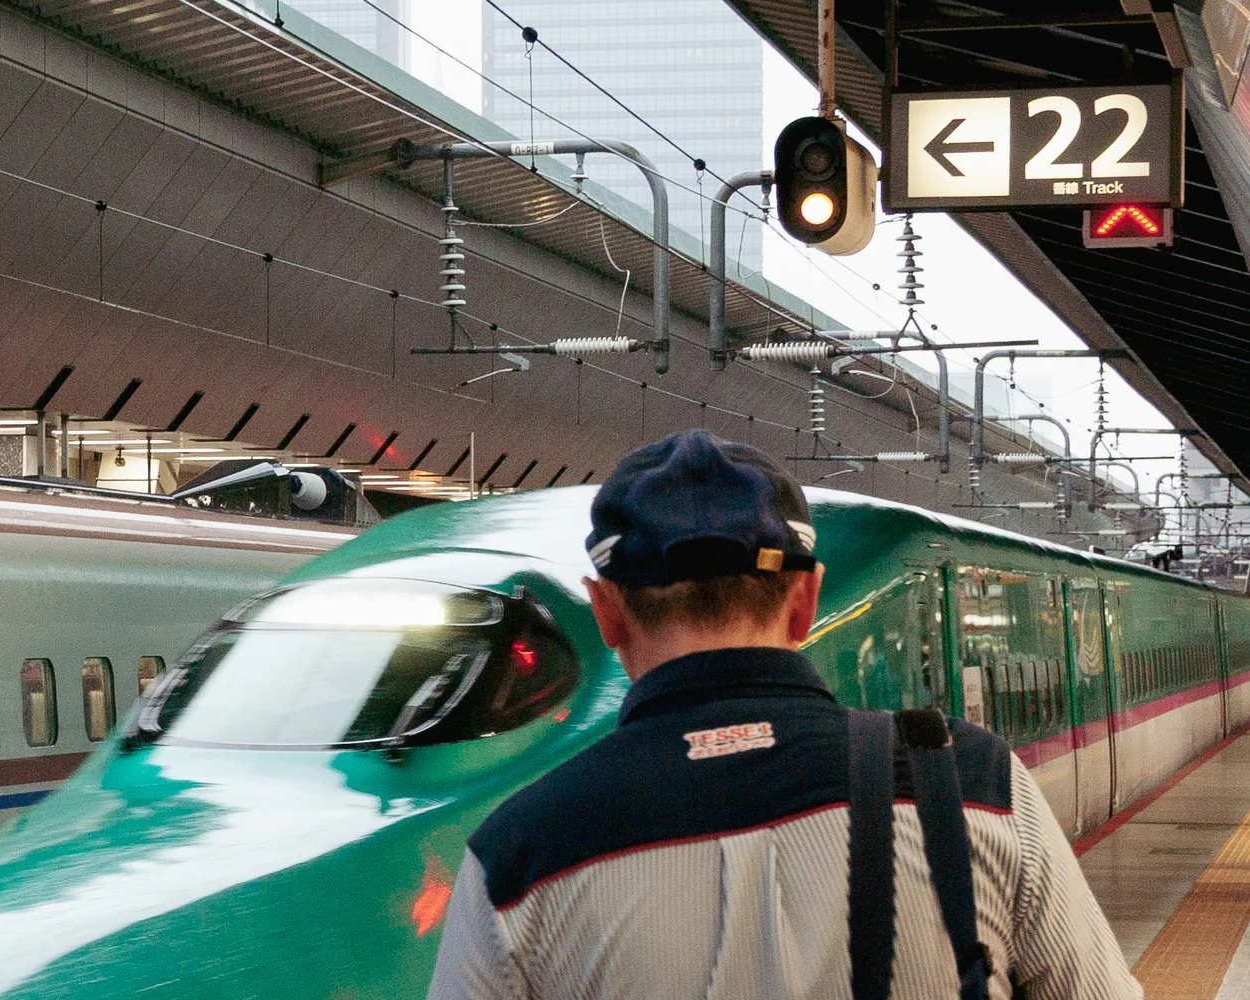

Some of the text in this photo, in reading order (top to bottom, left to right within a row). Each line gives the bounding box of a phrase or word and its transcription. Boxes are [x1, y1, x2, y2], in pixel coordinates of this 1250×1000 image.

[1025, 94, 1150, 180] 22
[1082, 181, 1124, 194] Track
[687, 721, 772, 746] TESSEI
